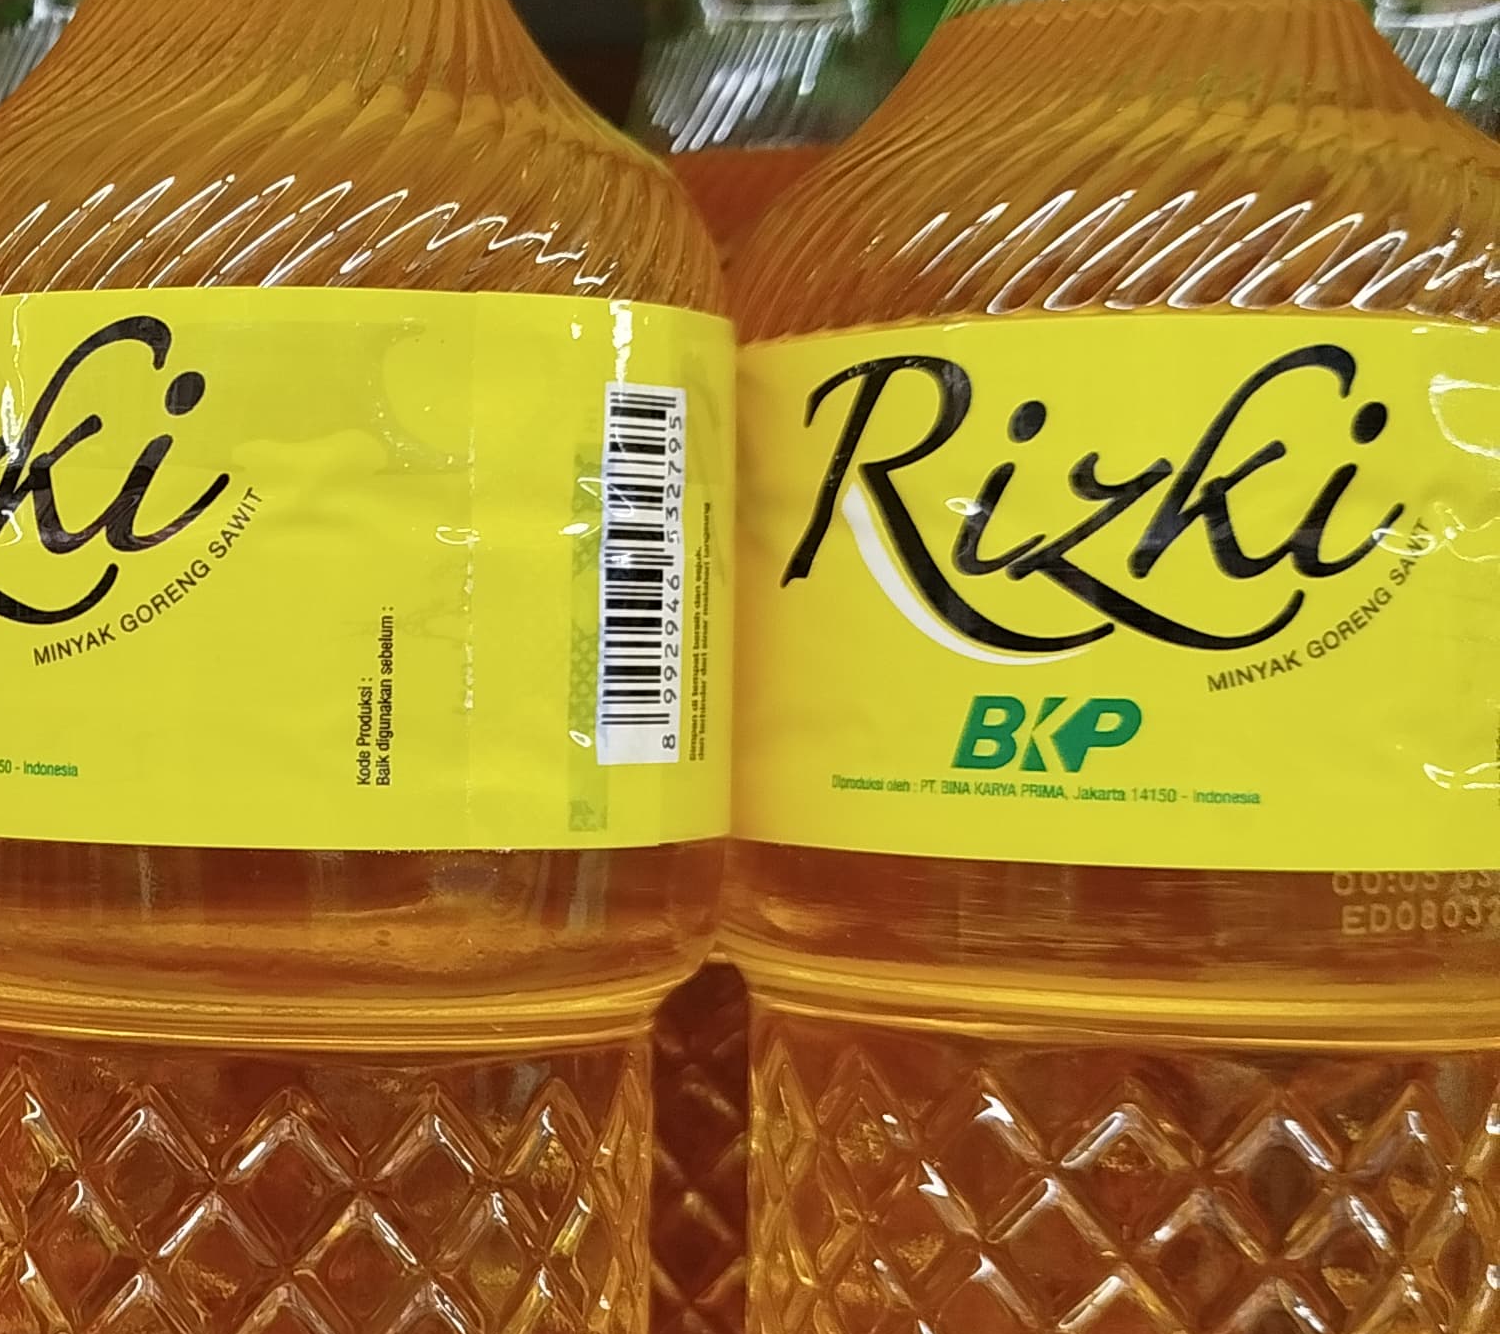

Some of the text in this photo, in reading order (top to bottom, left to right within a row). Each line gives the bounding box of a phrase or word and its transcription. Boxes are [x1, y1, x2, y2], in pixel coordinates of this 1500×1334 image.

[780, 343, 1405, 652] Rizki
[33, 487, 262, 666] MINYAK GORENG SAWIT
[378, 615, 394, 675] sebelum
[1207, 650, 1302, 692] MINYAK
[1306, 587, 1393, 659] GORENG
[356, 686, 372, 746] Produksi
[376, 679, 393, 752] digunakan
[951, 695, 1143, 772] BKP
[23, 761, 79, 777] Indonesia
[356, 750, 371, 785] Kode
[376, 755, 390, 786] Baik
[941, 780, 970, 795] BINA
[974, 781, 1016, 797] KARYA
[1073, 785, 1126, 802] Jakarta
[1130, 787, 1177, 803] 14150
[1193, 789, 1261, 804] Indonesia
